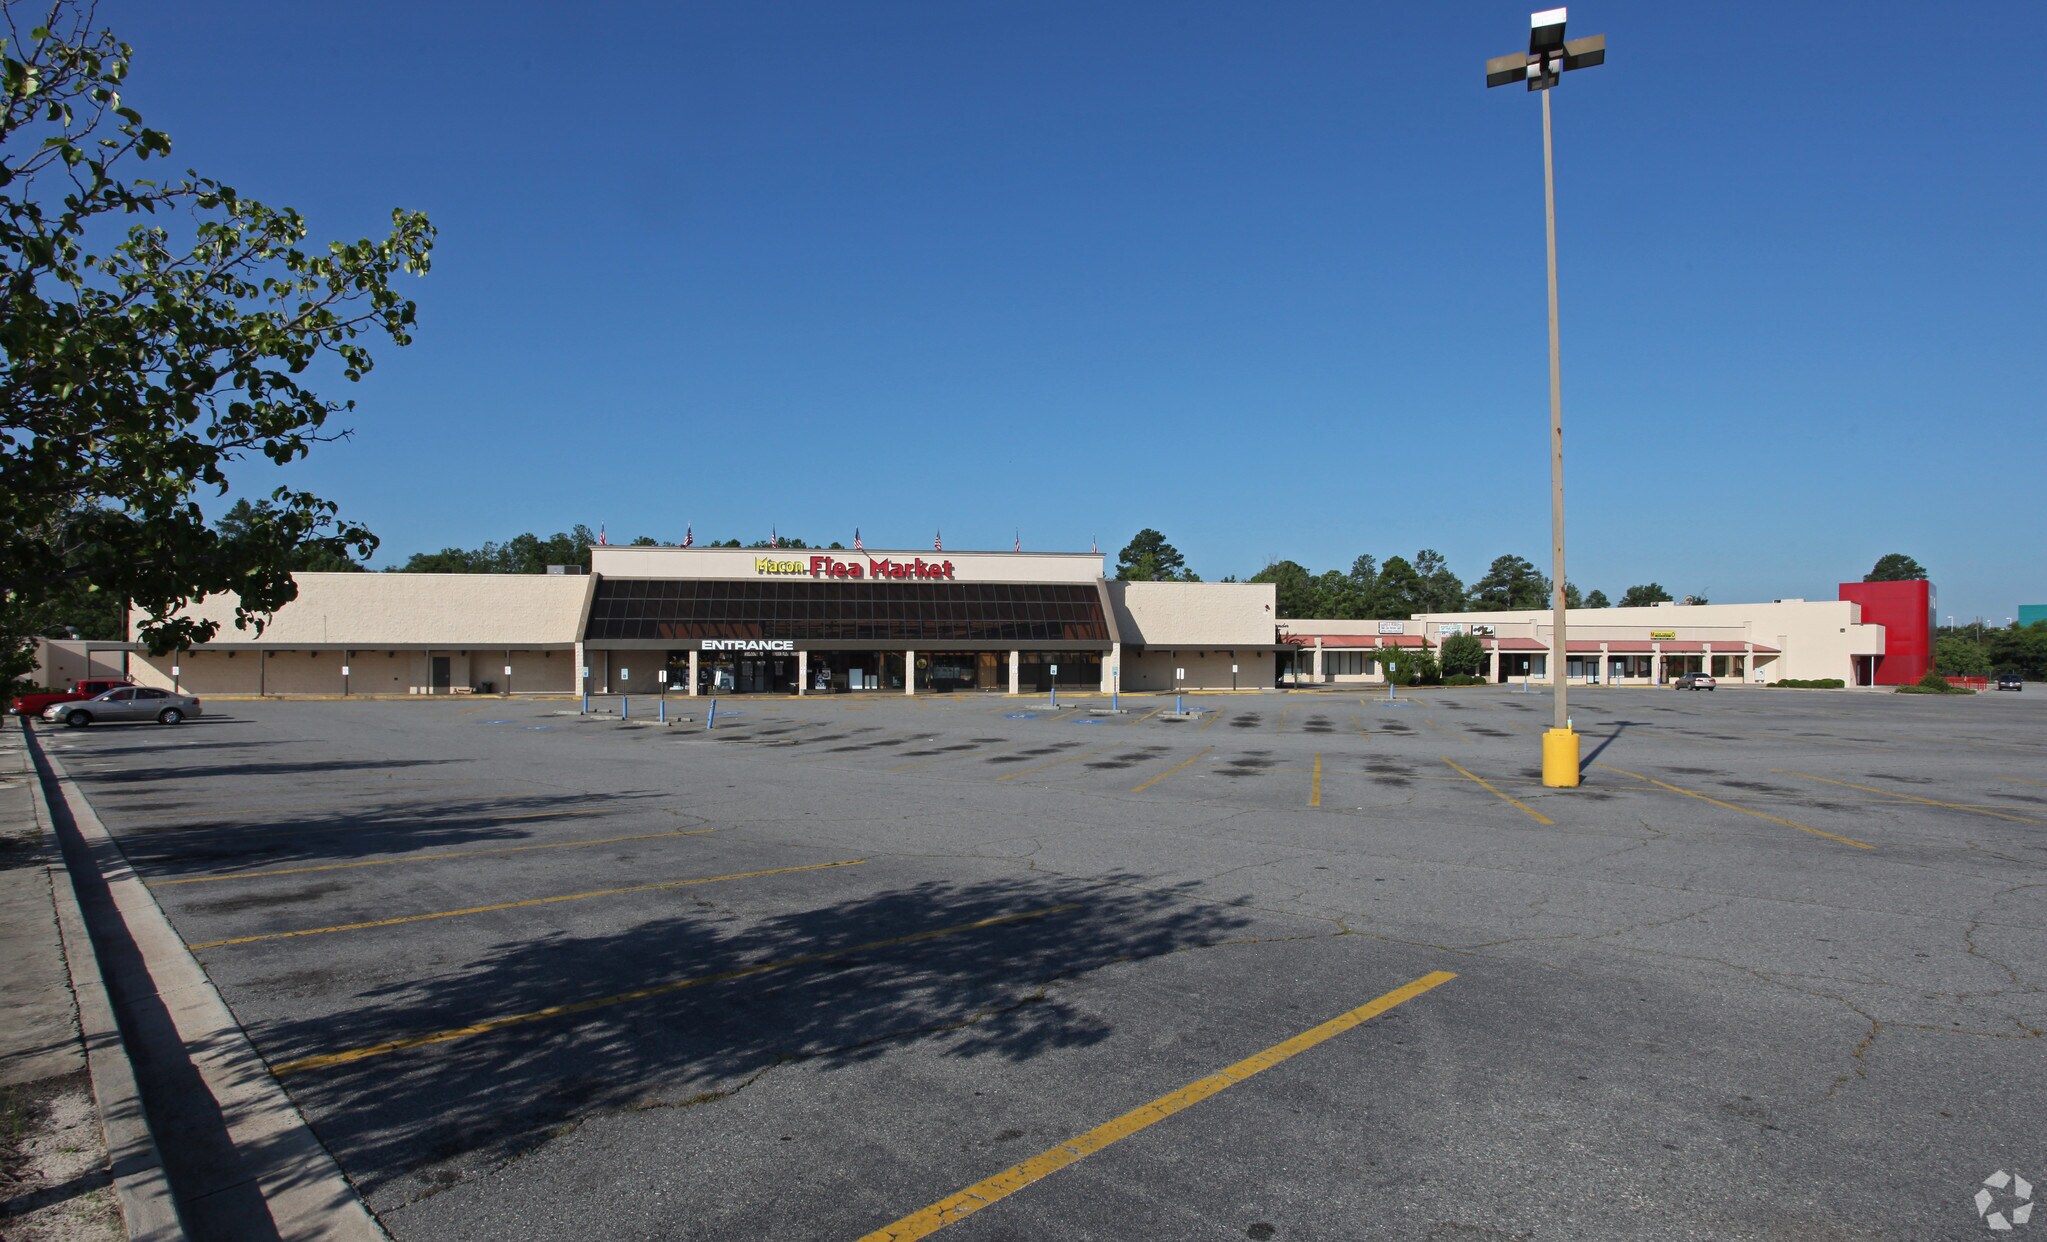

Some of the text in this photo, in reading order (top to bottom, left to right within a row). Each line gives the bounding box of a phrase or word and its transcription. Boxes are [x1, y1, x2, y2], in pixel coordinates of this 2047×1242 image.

[754, 556, 954, 578] Macon Flea Market
[701, 640, 794, 650] ENTRANCE
